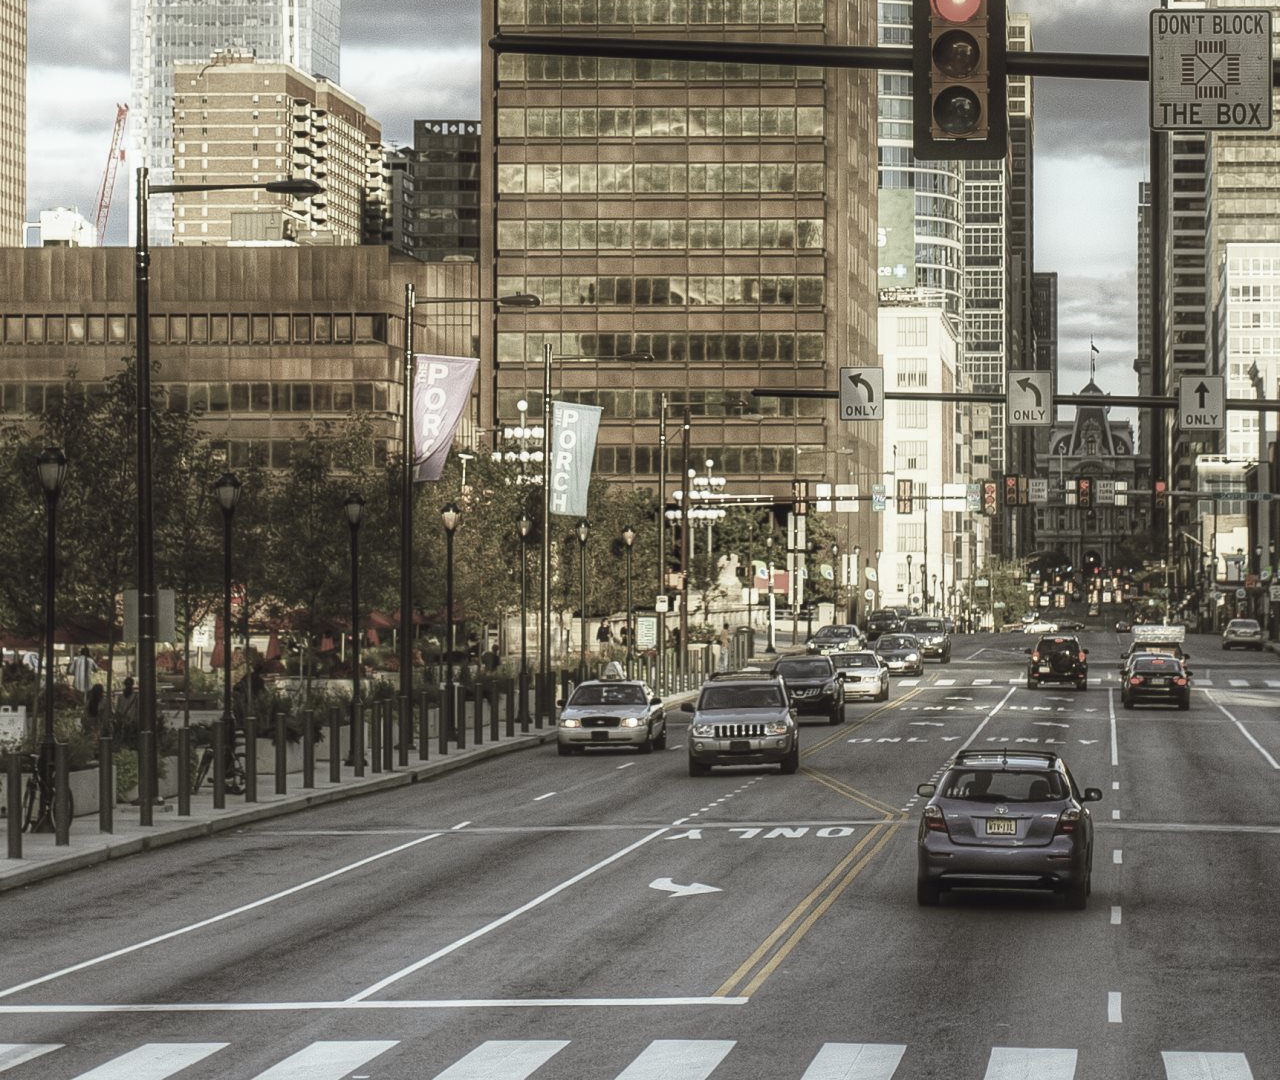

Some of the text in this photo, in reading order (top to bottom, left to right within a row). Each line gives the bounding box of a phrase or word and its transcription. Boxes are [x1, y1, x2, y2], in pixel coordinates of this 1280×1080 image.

[1158, 15, 1264, 35] DON'T BLOCK
[1159, 103, 1262, 125] THE BOX
[417, 362, 428, 384] THE
[554, 408, 563, 426] THE
[845, 405, 878, 417] ONLY
[1013, 409, 1046, 421] ONLY
[1185, 414, 1218, 425] ONLY
[552, 409, 579, 513] PORCH
[664, 826, 856, 840] ONLY
